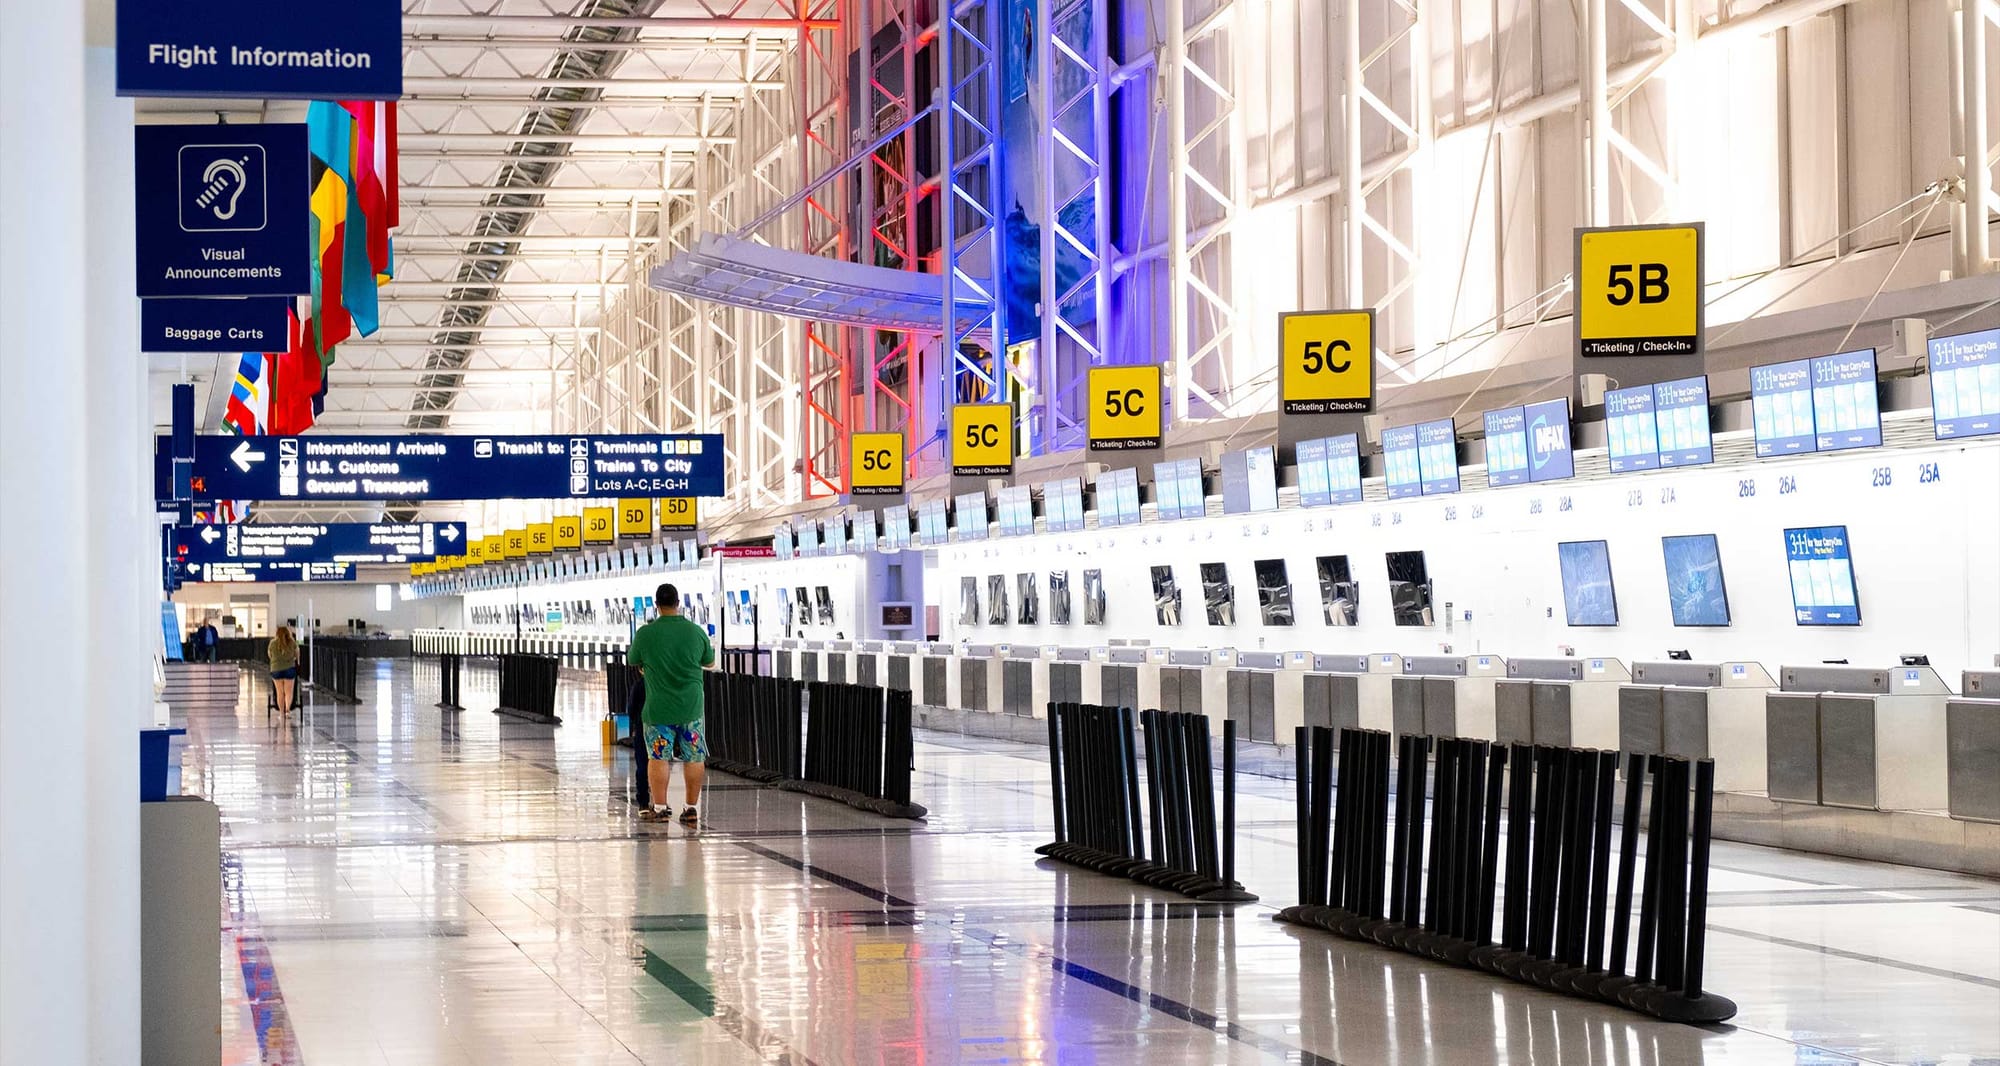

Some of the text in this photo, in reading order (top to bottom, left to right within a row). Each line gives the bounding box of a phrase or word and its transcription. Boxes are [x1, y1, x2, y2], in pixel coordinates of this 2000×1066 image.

[149, 44, 371, 68] Flight Information
[201, 247, 245, 261] Visual
[165, 264, 282, 280] Announcements
[1607, 263, 1670, 306] 5B
[165, 326, 264, 341] Baggage Carts
[1591, 342, 1634, 354] Ticketing
[1643, 340, 1686, 351] Check-In
[1935, 341, 1957, 366] 3-1-1
[1303, 339, 1352, 374] 5C
[1816, 360, 1835, 383] 3-1-1
[1755, 368, 1774, 391] 3-1-1
[1105, 388, 1145, 418] 5C
[1291, 403, 1324, 413] Ticketing
[1330, 401, 1363, 411] Check-In
[966, 424, 999, 448] 5C
[306, 442, 446, 455] International Arrivals
[497, 442, 564, 454] Transit to:
[594, 441, 658, 454] Terminals
[1096, 441, 1123, 449] Ticketing
[1127, 440, 1154, 448] Check-In
[306, 461, 399, 474] U.S. Customs
[594, 459, 692, 474] Trains To City
[863, 450, 892, 471] 5C
[1872, 466, 1892, 487] 25B
[1919, 462, 1940, 483] 25A
[306, 480, 429, 494] Ground Transport
[595, 479, 621, 491] Lots
[625, 479, 689, 492] A-C,E-G-H
[1739, 479, 1756, 497] 26B
[1779, 476, 1797, 495] 26A
[668, 499, 688, 514] 5D
[626, 509, 644, 523] 5D
[590, 518, 606, 531] 5D
[533, 532, 546, 544] 5E
[559, 526, 575, 538] 5D
[489, 543, 500, 553] 5E
[510, 538, 522, 549] 5E
[1790, 533, 1810, 555] 3-1-1
[471, 548, 481, 558] 5E
[722, 549, 743, 557] ecurity
